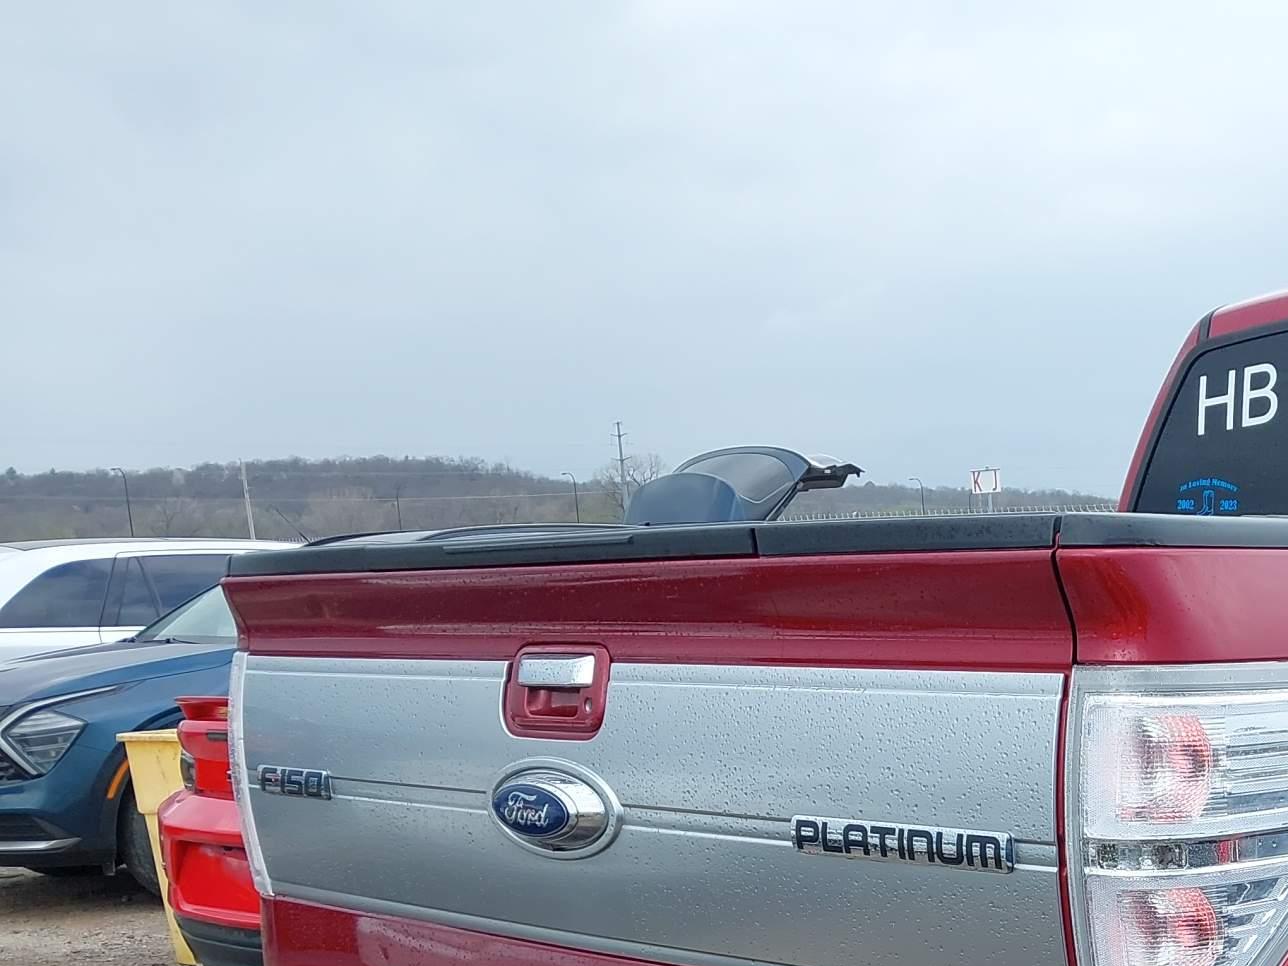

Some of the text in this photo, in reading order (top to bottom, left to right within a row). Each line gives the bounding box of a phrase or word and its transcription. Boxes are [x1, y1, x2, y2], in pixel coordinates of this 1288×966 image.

[1198, 363, 1278, 435] HB
[1188, 478, 1211, 489] Loving
[1211, 478, 1238, 492] Memory
[1177, 499, 1195, 510] 2002
[1219, 499, 1237, 511] 2023
[504, 791, 549, 828] Ford
[795, 819, 1003, 870] PLATINUM
